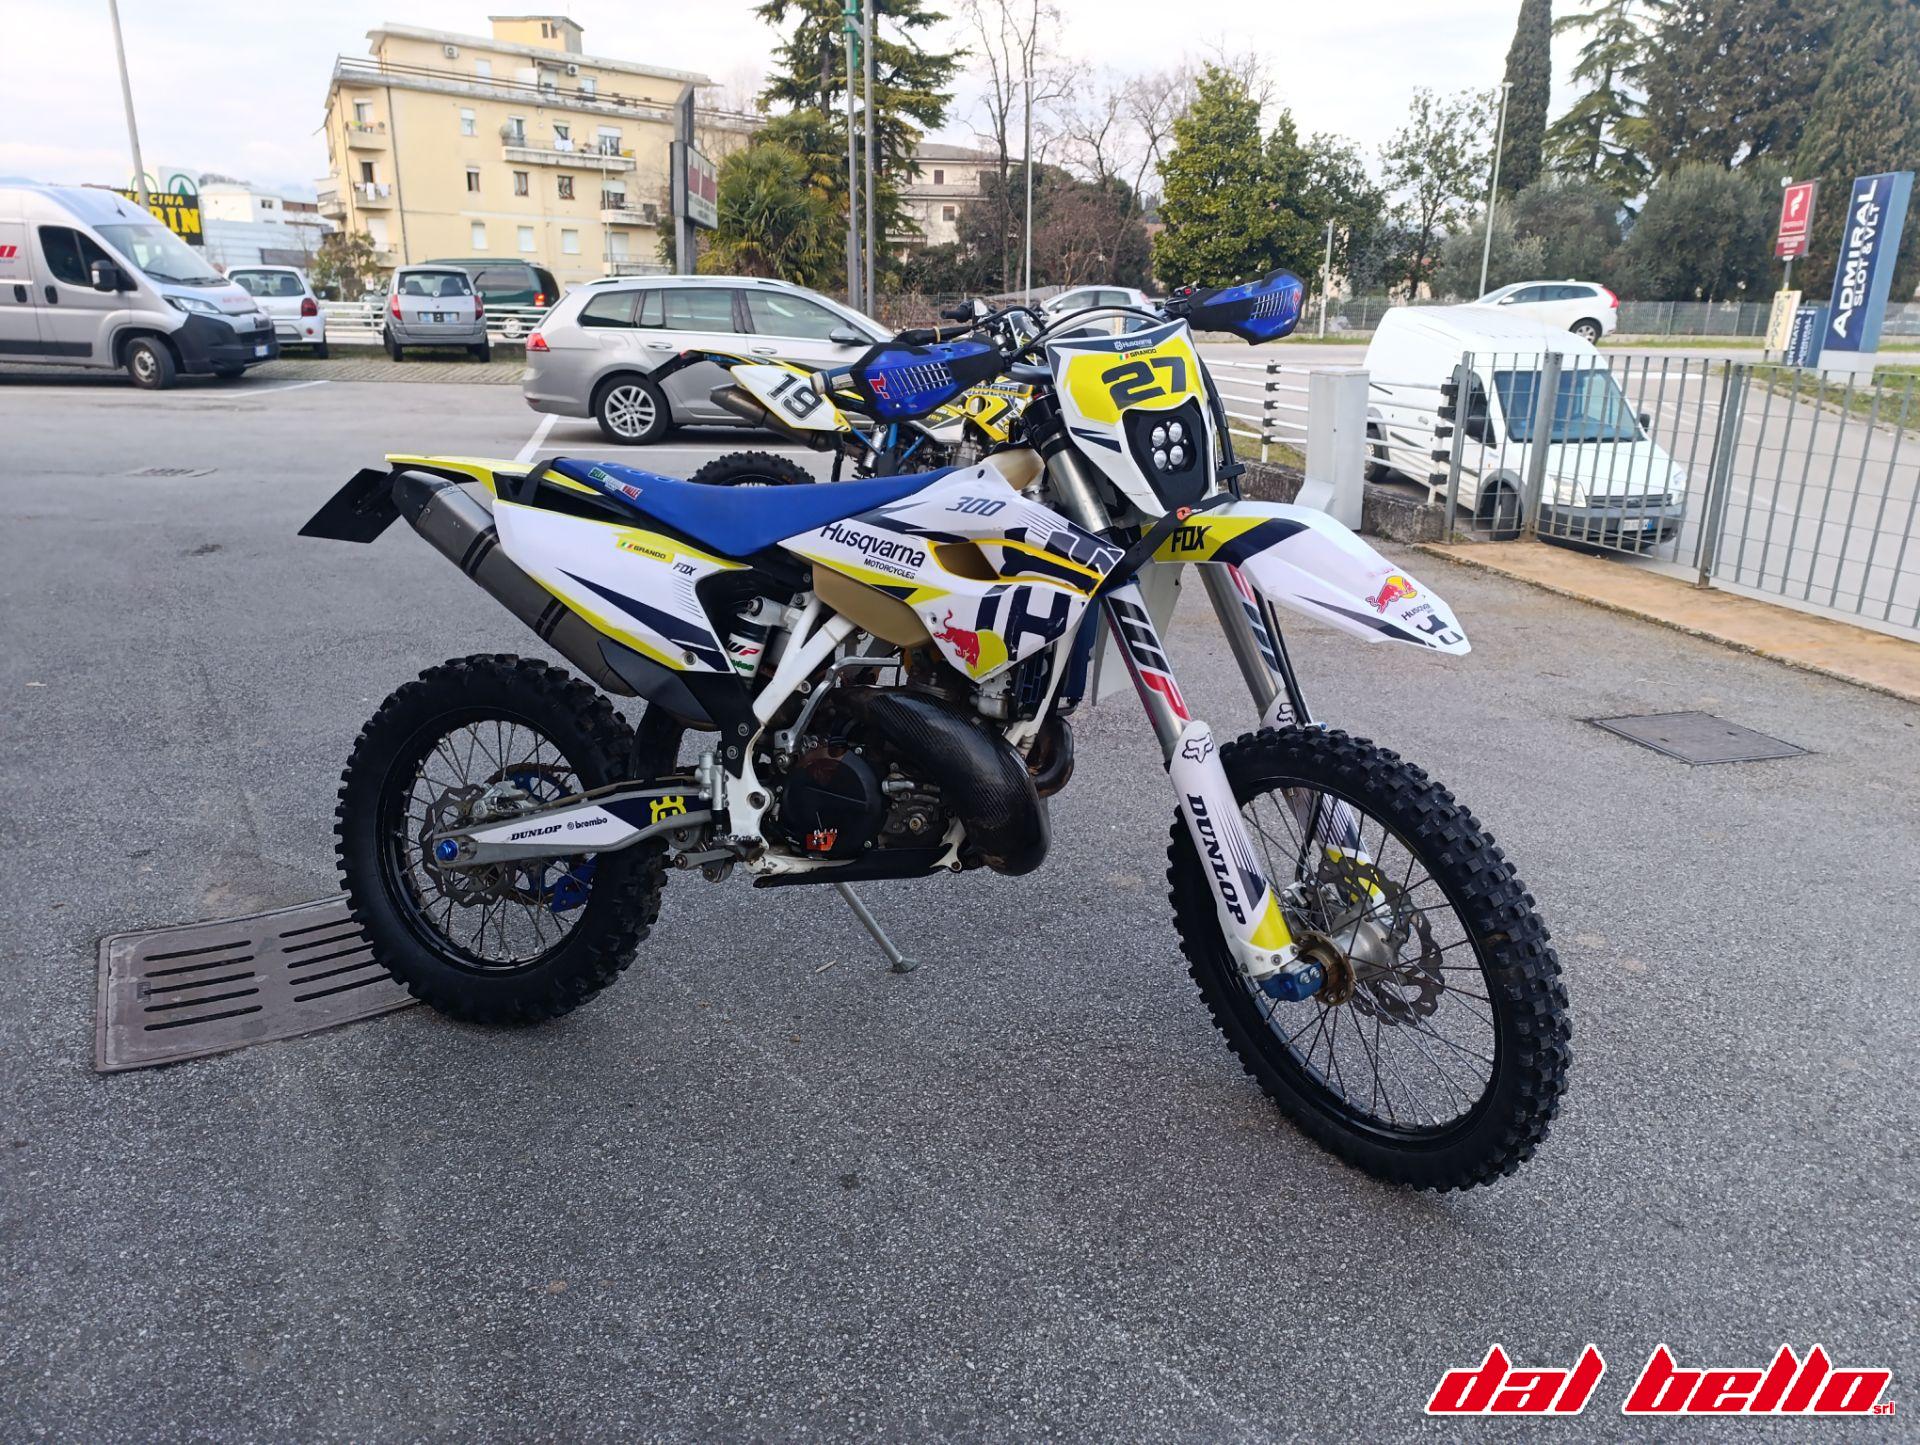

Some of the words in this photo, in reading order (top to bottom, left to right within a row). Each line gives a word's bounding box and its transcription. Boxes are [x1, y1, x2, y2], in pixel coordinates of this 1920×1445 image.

[1833, 179, 1878, 339] ADMIRAL
[1854, 259, 1869, 306] SLOT
[766, 373, 825, 420] 19
[1101, 356, 1187, 410] 27
[945, 496, 1007, 517] 300
[633, 545, 667, 559] GRANDO
[820, 521, 926, 568] Husqvarna
[1170, 525, 1213, 553] FOX
[673, 562, 698, 576] FOX
[863, 557, 917, 580] MOTORCYCLES
[510, 824, 563, 841] DUNLOP
[575, 817, 608, 830] brembo
[1185, 793, 1247, 925] DUNLOP
